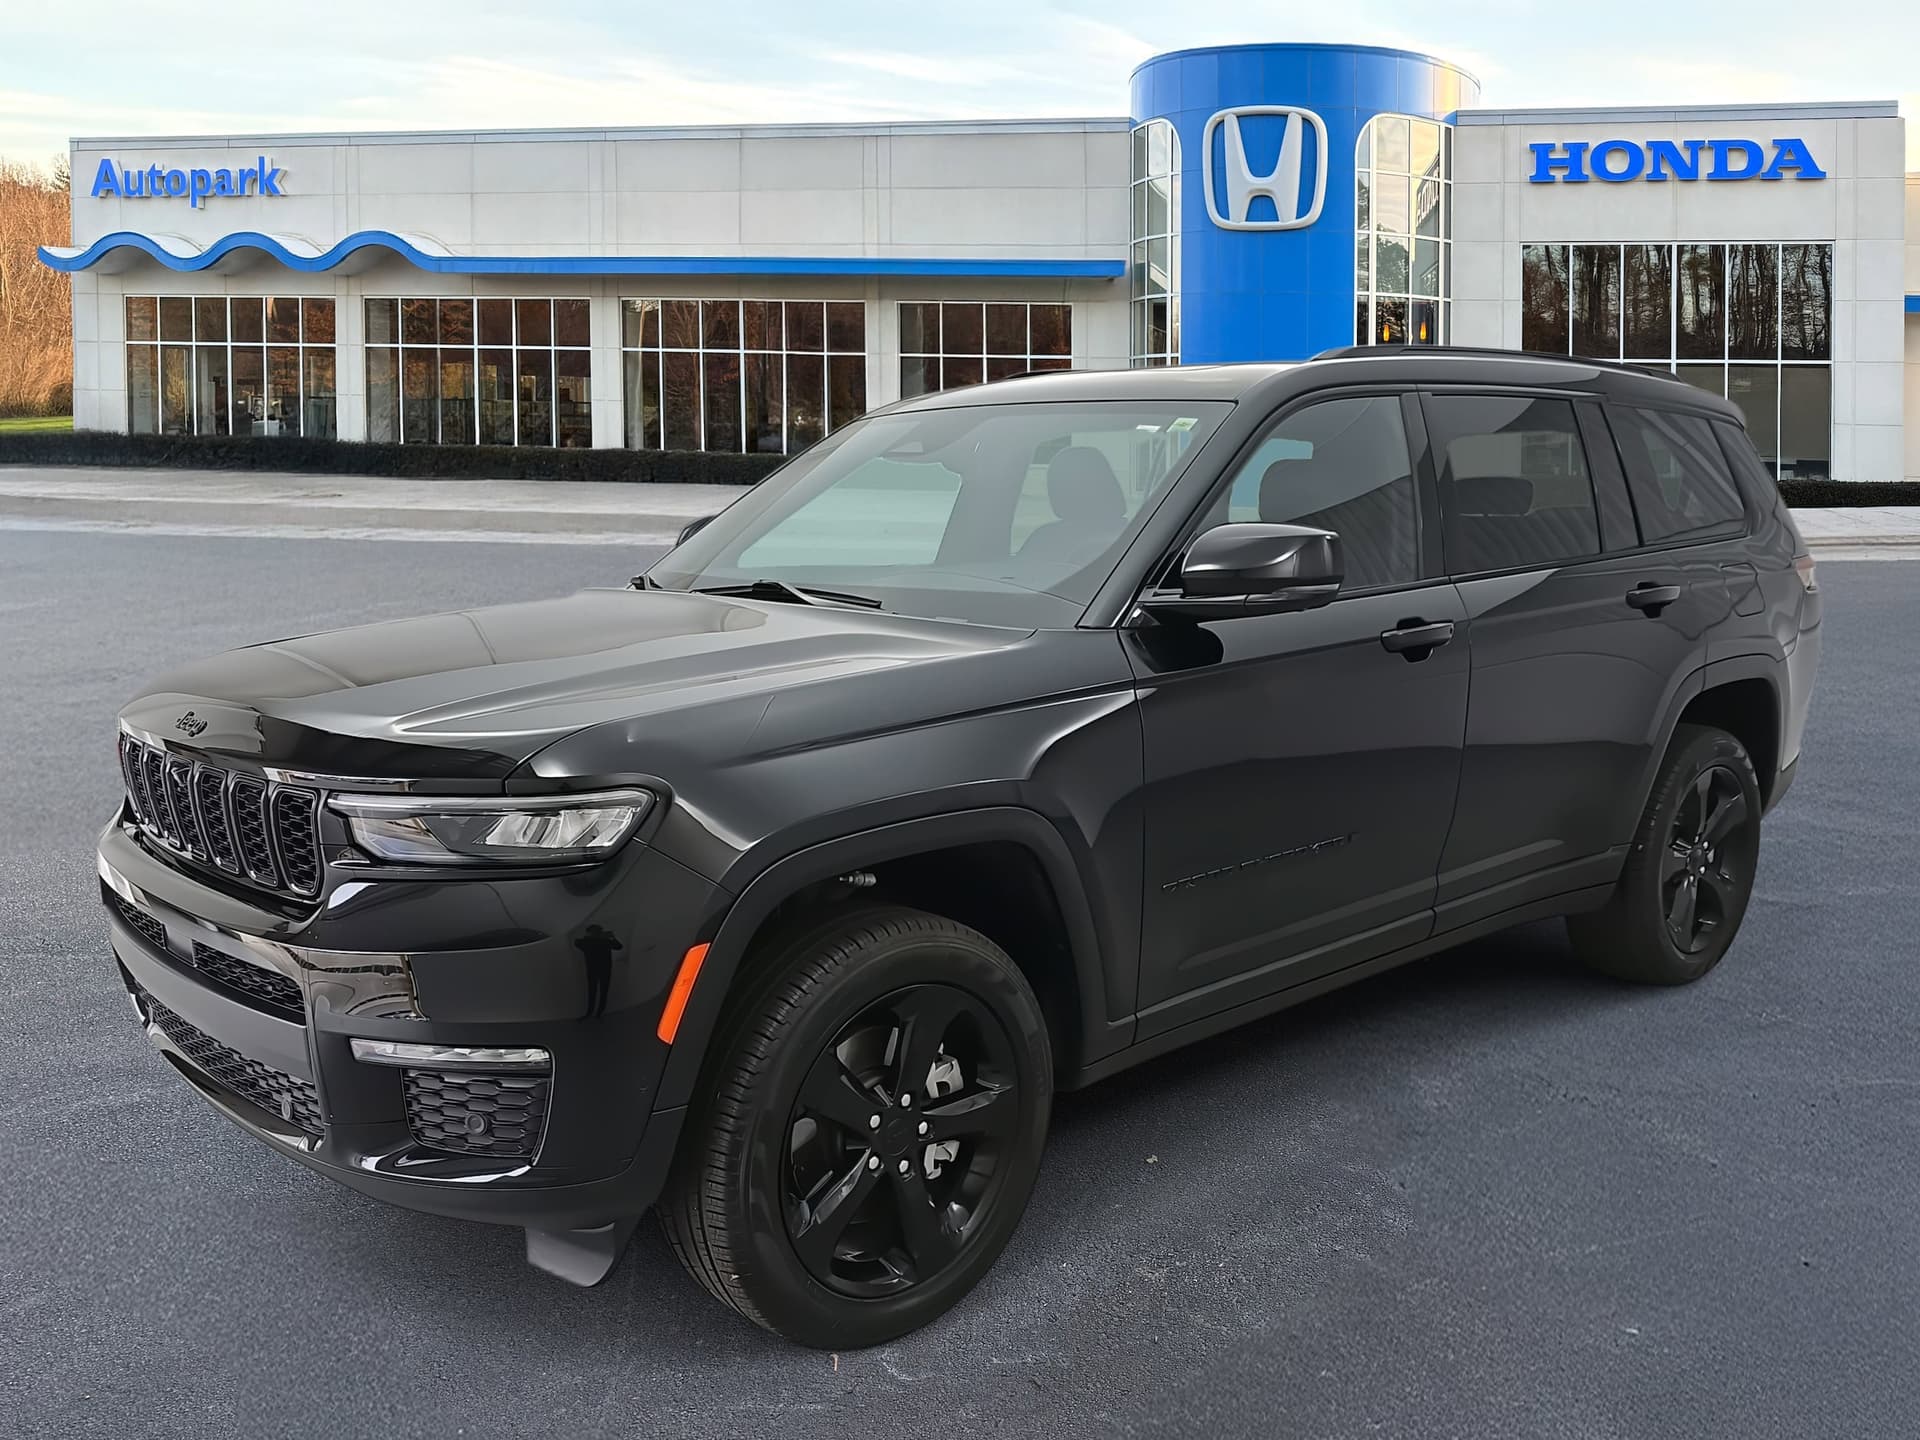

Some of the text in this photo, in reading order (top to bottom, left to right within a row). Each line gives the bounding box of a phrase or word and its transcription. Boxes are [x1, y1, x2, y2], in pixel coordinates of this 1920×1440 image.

[91, 155, 282, 208] Autopark
[1528, 138, 1826, 183] HONDA
[175, 711, 208, 738] Jeep
